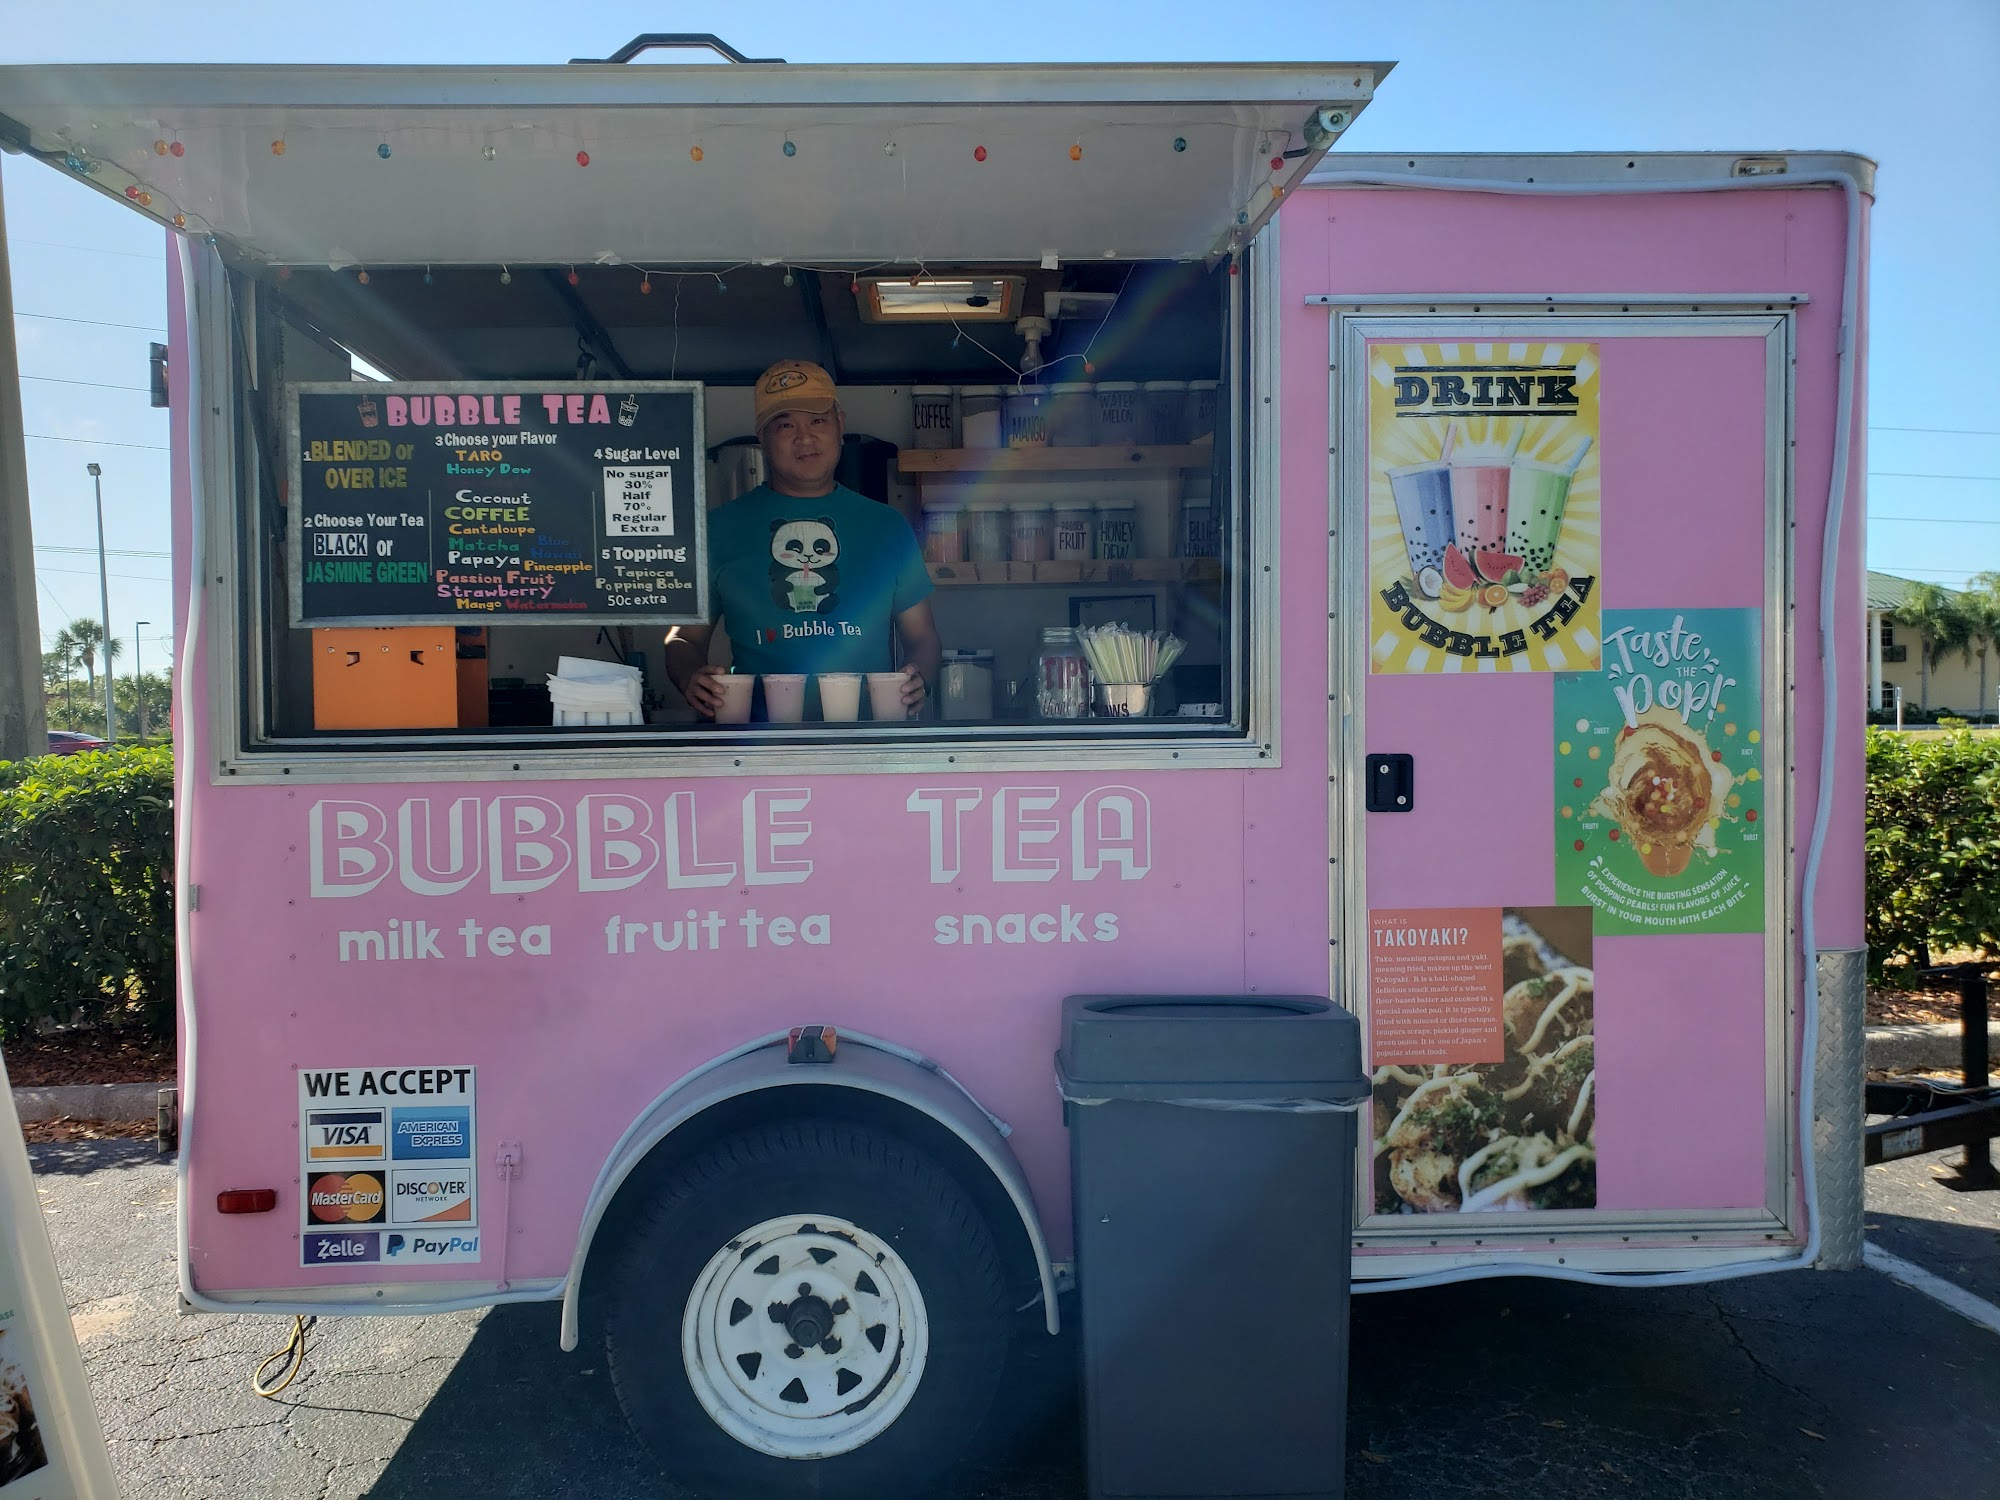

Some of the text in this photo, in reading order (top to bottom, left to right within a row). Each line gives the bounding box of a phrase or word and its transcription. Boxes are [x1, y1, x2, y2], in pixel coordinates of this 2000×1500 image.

[1394, 375, 1579, 407] DRINK
[386, 394, 611, 426] BUBBLE TEA
[914, 403, 951, 430] COFFEE
[492, 434, 518, 448] your
[520, 432, 557, 445] Flavor
[396, 443, 414, 460] or
[456, 450, 502, 462] TARO
[605, 447, 642, 462] Sugar
[645, 447, 680, 460] Level
[325, 467, 407, 489] OVER ICE
[446, 464, 531, 478] Honey Dew
[606, 470, 669, 480] No sugar
[624, 480, 652, 489] 30%
[455, 489, 532, 504] Coconut
[623, 491, 651, 500] Half
[444, 506, 530, 522] COFFEE
[624, 502, 651, 511] 70%
[314, 514, 363, 527] Choose
[367, 513, 397, 527] Your
[400, 513, 424, 527] Tea
[612, 513, 667, 523] Regular
[449, 523, 536, 537] Cantaloupe
[621, 524, 660, 533] Extra
[1100, 521, 1136, 542] HONEY
[314, 533, 393, 556] BLACK or
[448, 538, 520, 551] Matcha
[1059, 532, 1086, 550] FRUIT
[448, 551, 520, 568] Papaya
[602, 544, 687, 563] 5 Topping
[306, 562, 428, 584] JASMINE GREEN
[523, 560, 593, 574] Pineapple
[614, 566, 675, 580] Tapioca
[436, 570, 556, 585] Passion Fruit
[656, 577, 692, 589] Boba
[437, 584, 553, 599] Strawberry
[456, 598, 502, 611] Mango
[608, 594, 667, 606] 50c extra
[1380, 575, 1596, 659] BUBBLE TEA
[756, 621, 862, 645] I Bubble Tea
[1602, 615, 1702, 675] Taste
[1043, 656, 1089, 690] TIPS
[1675, 666, 1698, 678] THE
[309, 785, 1151, 899] BUBBLE TEA
[1587, 870, 1598, 881] OF
[1595, 879, 1626, 904] POPPING
[1660, 903, 1675, 911] FUN
[1677, 895, 1710, 910] FLAVORS
[1711, 889, 1721, 900] OF
[1722, 874, 1741, 894] JUICE
[1601, 867, 1728, 900] EXPERIENCE THE BURSTING SENSATION
[1581, 885, 1746, 926] BURST IN YOUR MOUTH WITH EACH BITE
[338, 904, 1119, 962] milk tea fruit tea snacks
[1374, 927, 1468, 947] TAKOYAKI?
[304, 1069, 471, 1098] WE ACCEPT
[322, 1126, 370, 1145] VISA
[398, 1121, 459, 1134] AMERICAN
[412, 1134, 463, 1147] EXPRESS
[396, 1181, 465, 1196] DISCOVER
[312, 1191, 381, 1206] MasterCard
[317, 1238, 365, 1260] Zelle
[413, 1237, 479, 1256] PayPal
